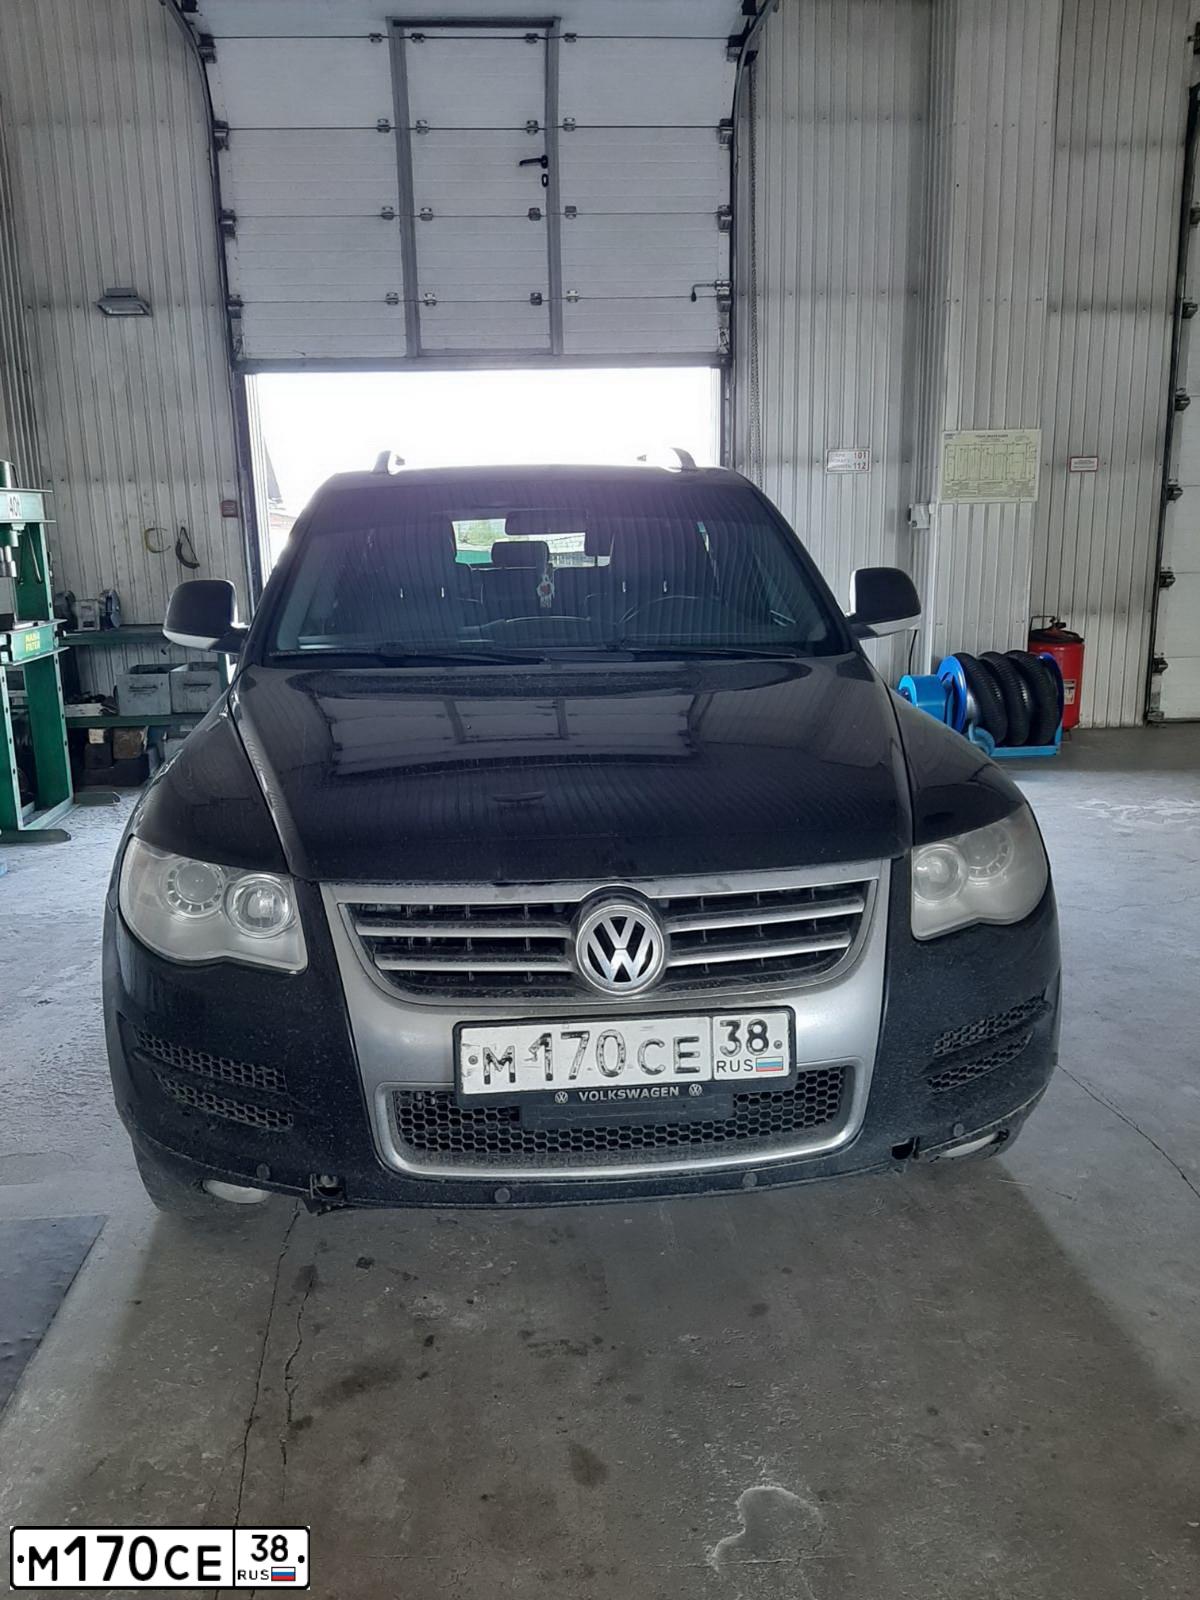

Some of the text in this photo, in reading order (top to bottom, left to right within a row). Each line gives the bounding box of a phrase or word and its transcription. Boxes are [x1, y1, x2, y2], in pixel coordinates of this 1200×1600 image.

[719, 1018, 770, 1057] 38
[716, 1058, 755, 1074] RUS
[578, 1085, 681, 1103] VOLKSWAGEN
